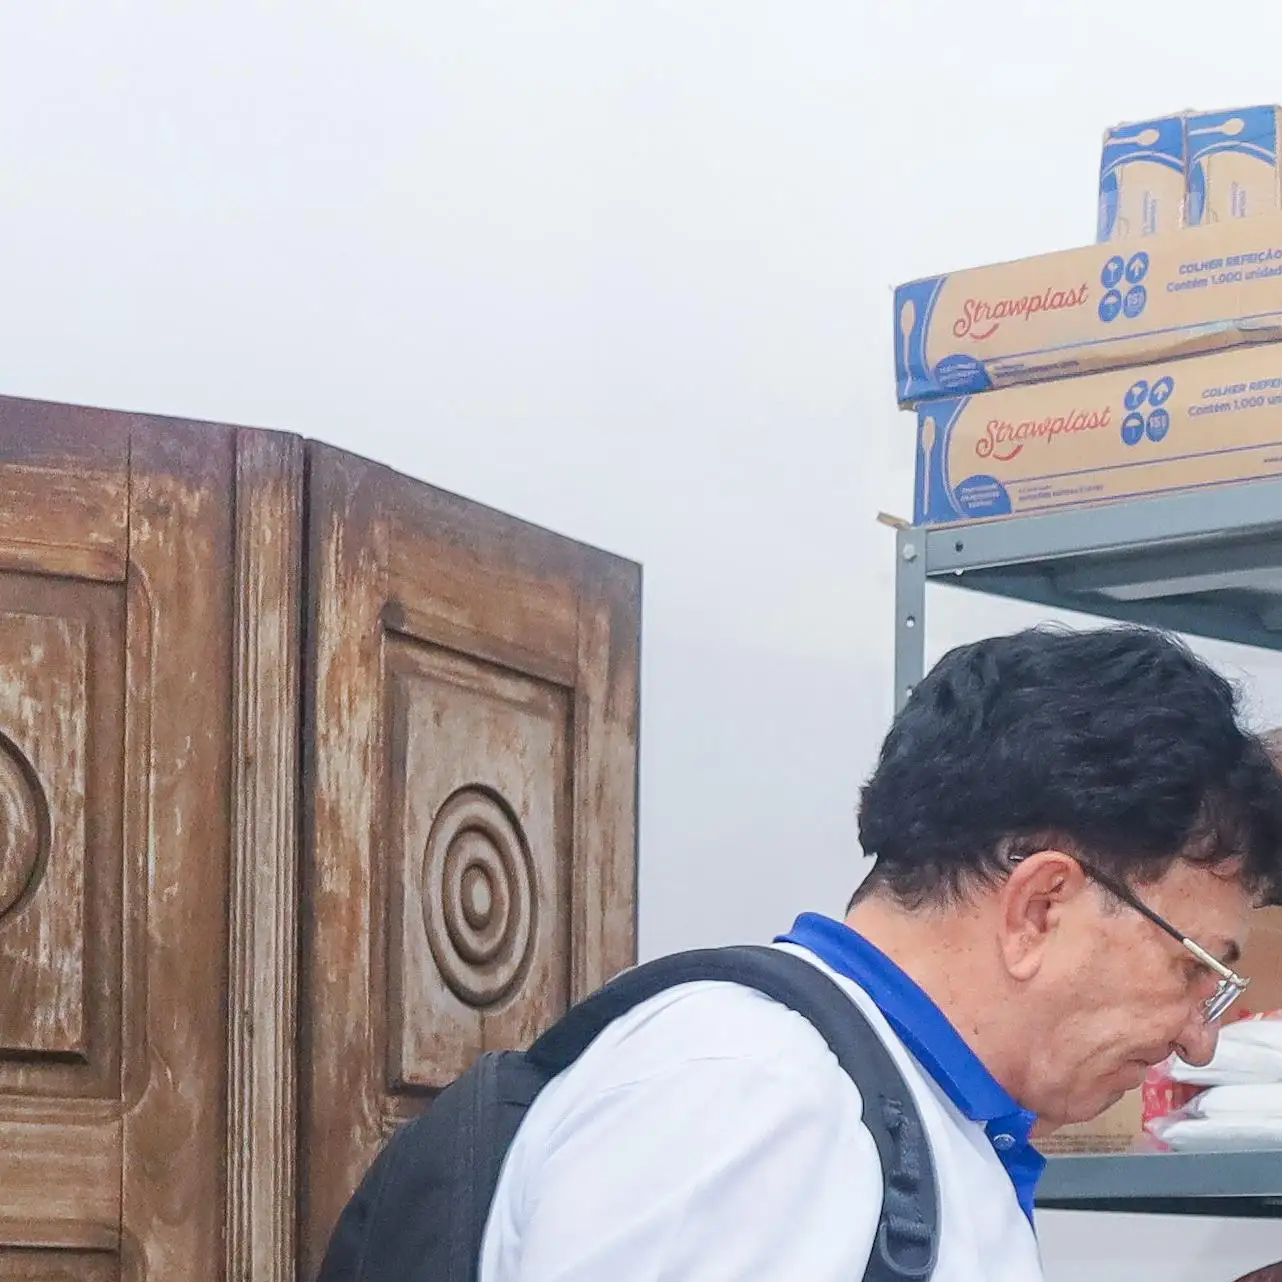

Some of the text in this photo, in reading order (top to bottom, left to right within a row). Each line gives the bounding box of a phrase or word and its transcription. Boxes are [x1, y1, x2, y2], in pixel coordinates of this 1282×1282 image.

[1179, 260, 1223, 275] COLHER
[1166, 278, 1209, 292] Contém
[953, 284, 1089, 340] Strawplast
[1201, 384, 1247, 398] COLHER
[1188, 400, 1231, 417] Contém
[975, 405, 1111, 460] Strawplast
